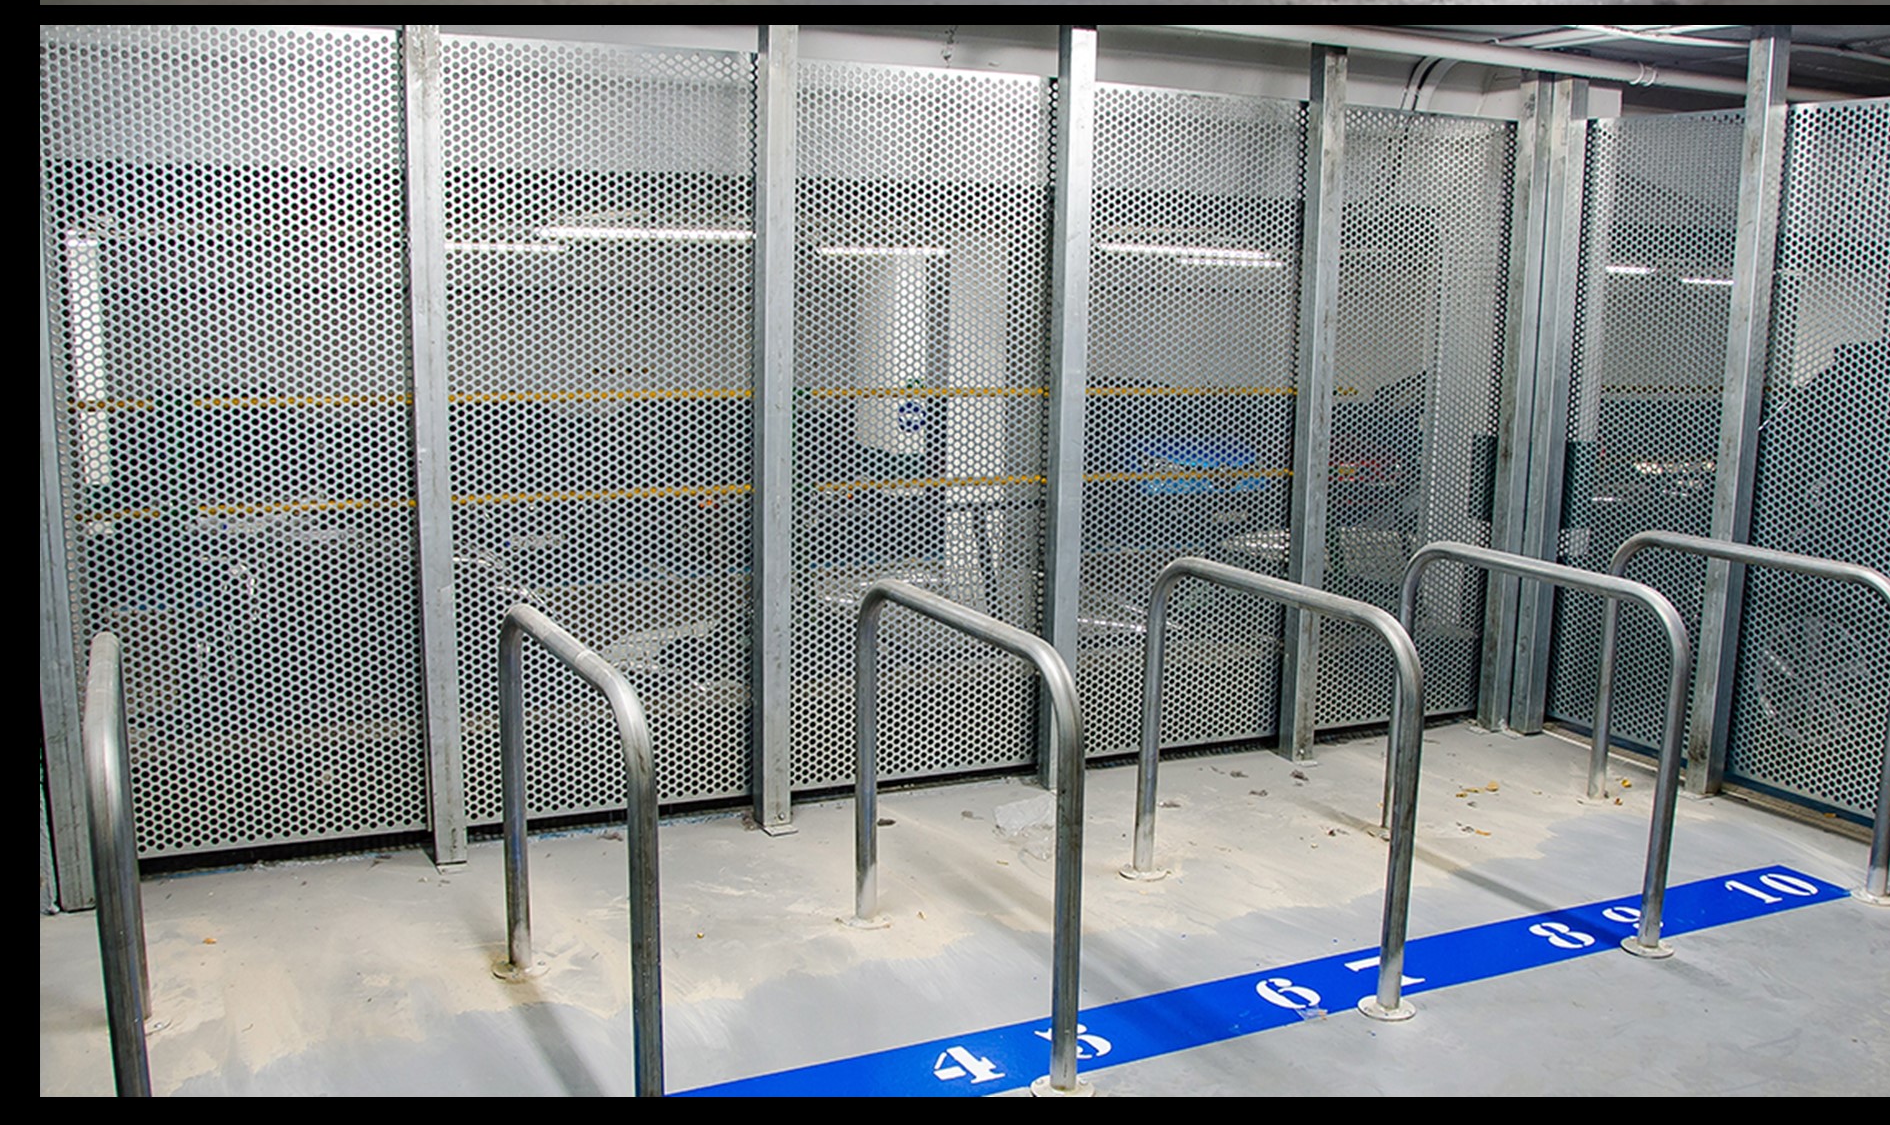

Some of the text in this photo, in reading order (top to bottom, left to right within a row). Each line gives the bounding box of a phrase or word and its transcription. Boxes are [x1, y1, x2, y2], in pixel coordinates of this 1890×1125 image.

[933, 1045, 1006, 1084] 4
[1256, 977, 1321, 1009] 6
[1529, 922, 1595, 949] 8
[1725, 873, 1819, 904] 10
